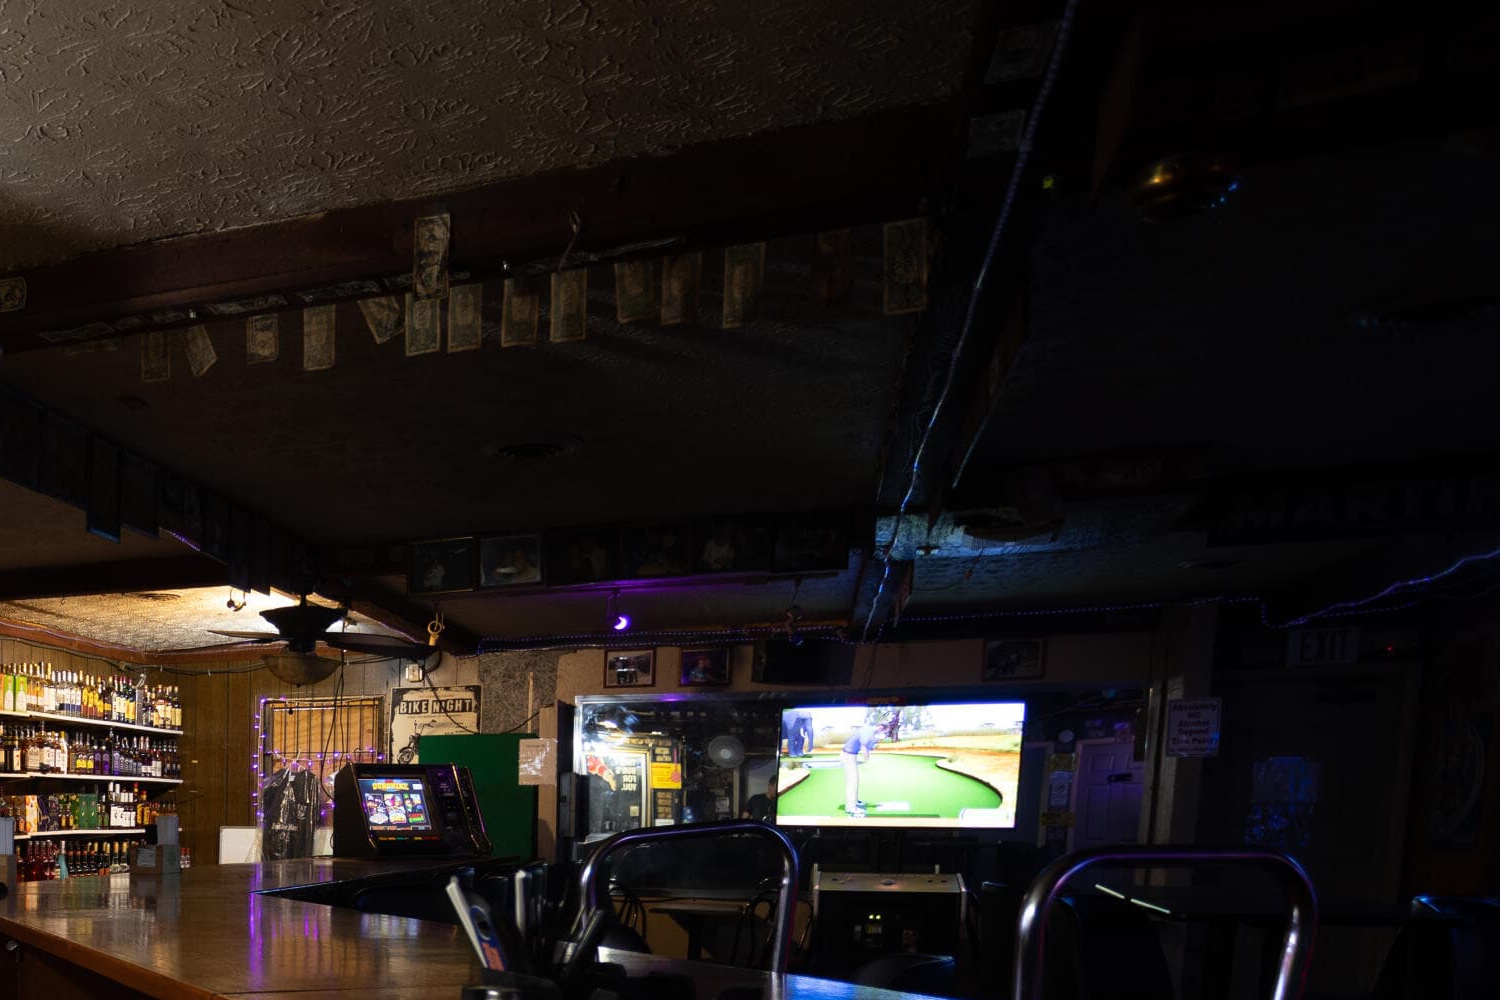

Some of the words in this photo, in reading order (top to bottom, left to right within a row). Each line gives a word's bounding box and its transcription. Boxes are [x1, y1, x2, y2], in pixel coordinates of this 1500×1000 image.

[1300, 631, 1348, 662] EXIT
[400, 702, 427, 713] BIKE
[433, 700, 471, 713] NIGHT
